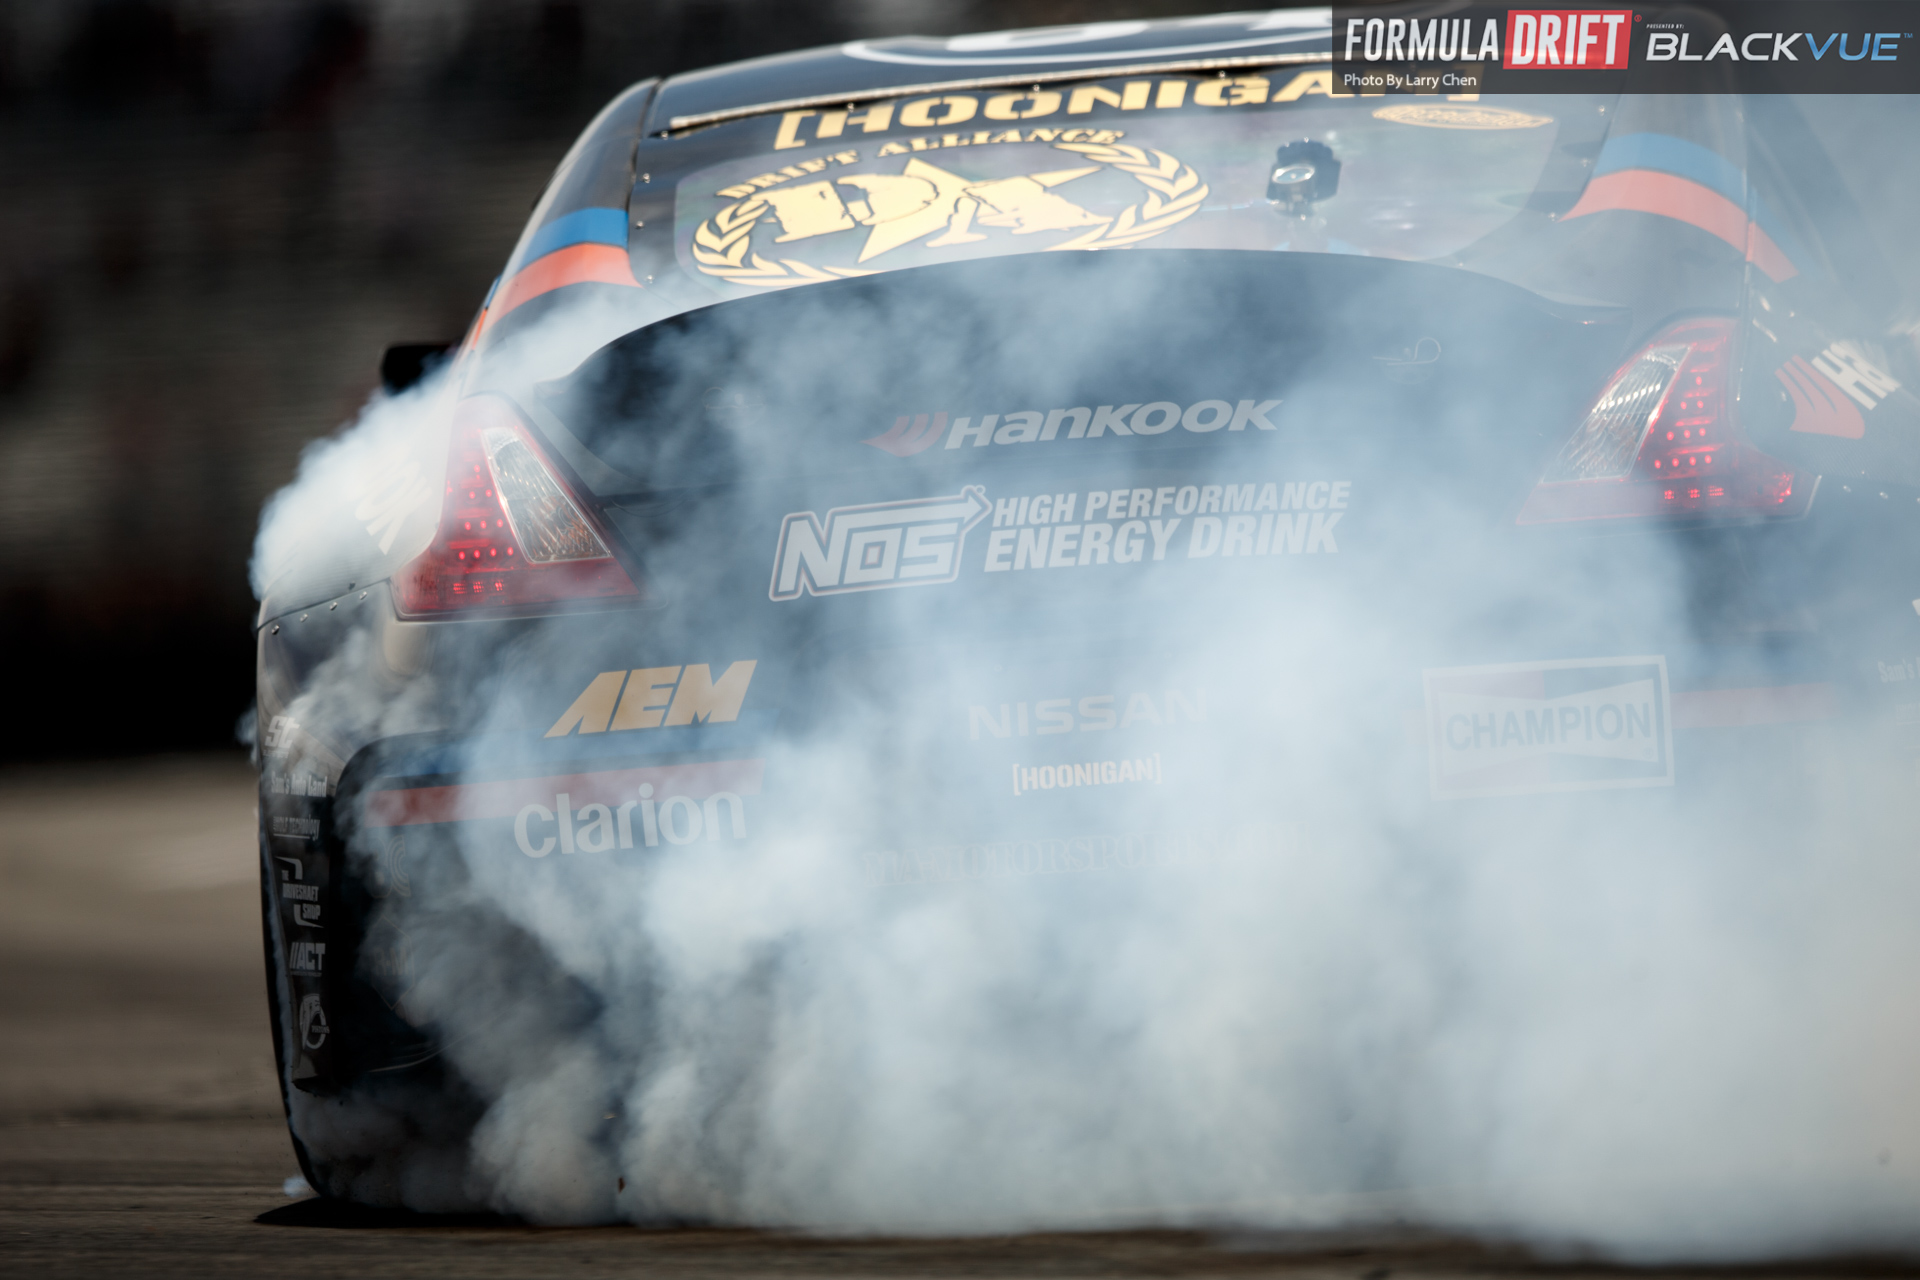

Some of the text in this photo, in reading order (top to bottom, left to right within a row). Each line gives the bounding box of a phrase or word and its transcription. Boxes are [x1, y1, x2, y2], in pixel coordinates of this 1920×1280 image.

[715, 128, 1126, 199] DRIFT ALLIANCE
[992, 481, 1352, 528] HIGH PERFORMANCE
[771, 485, 991, 601] NOS
[984, 512, 1346, 573] ENERGY DRINK
[543, 659, 758, 739] AEM
[967, 687, 1208, 740] NISSAN
[1445, 700, 1652, 752] CHAMPION
[302, 903, 321, 921] SHOP
